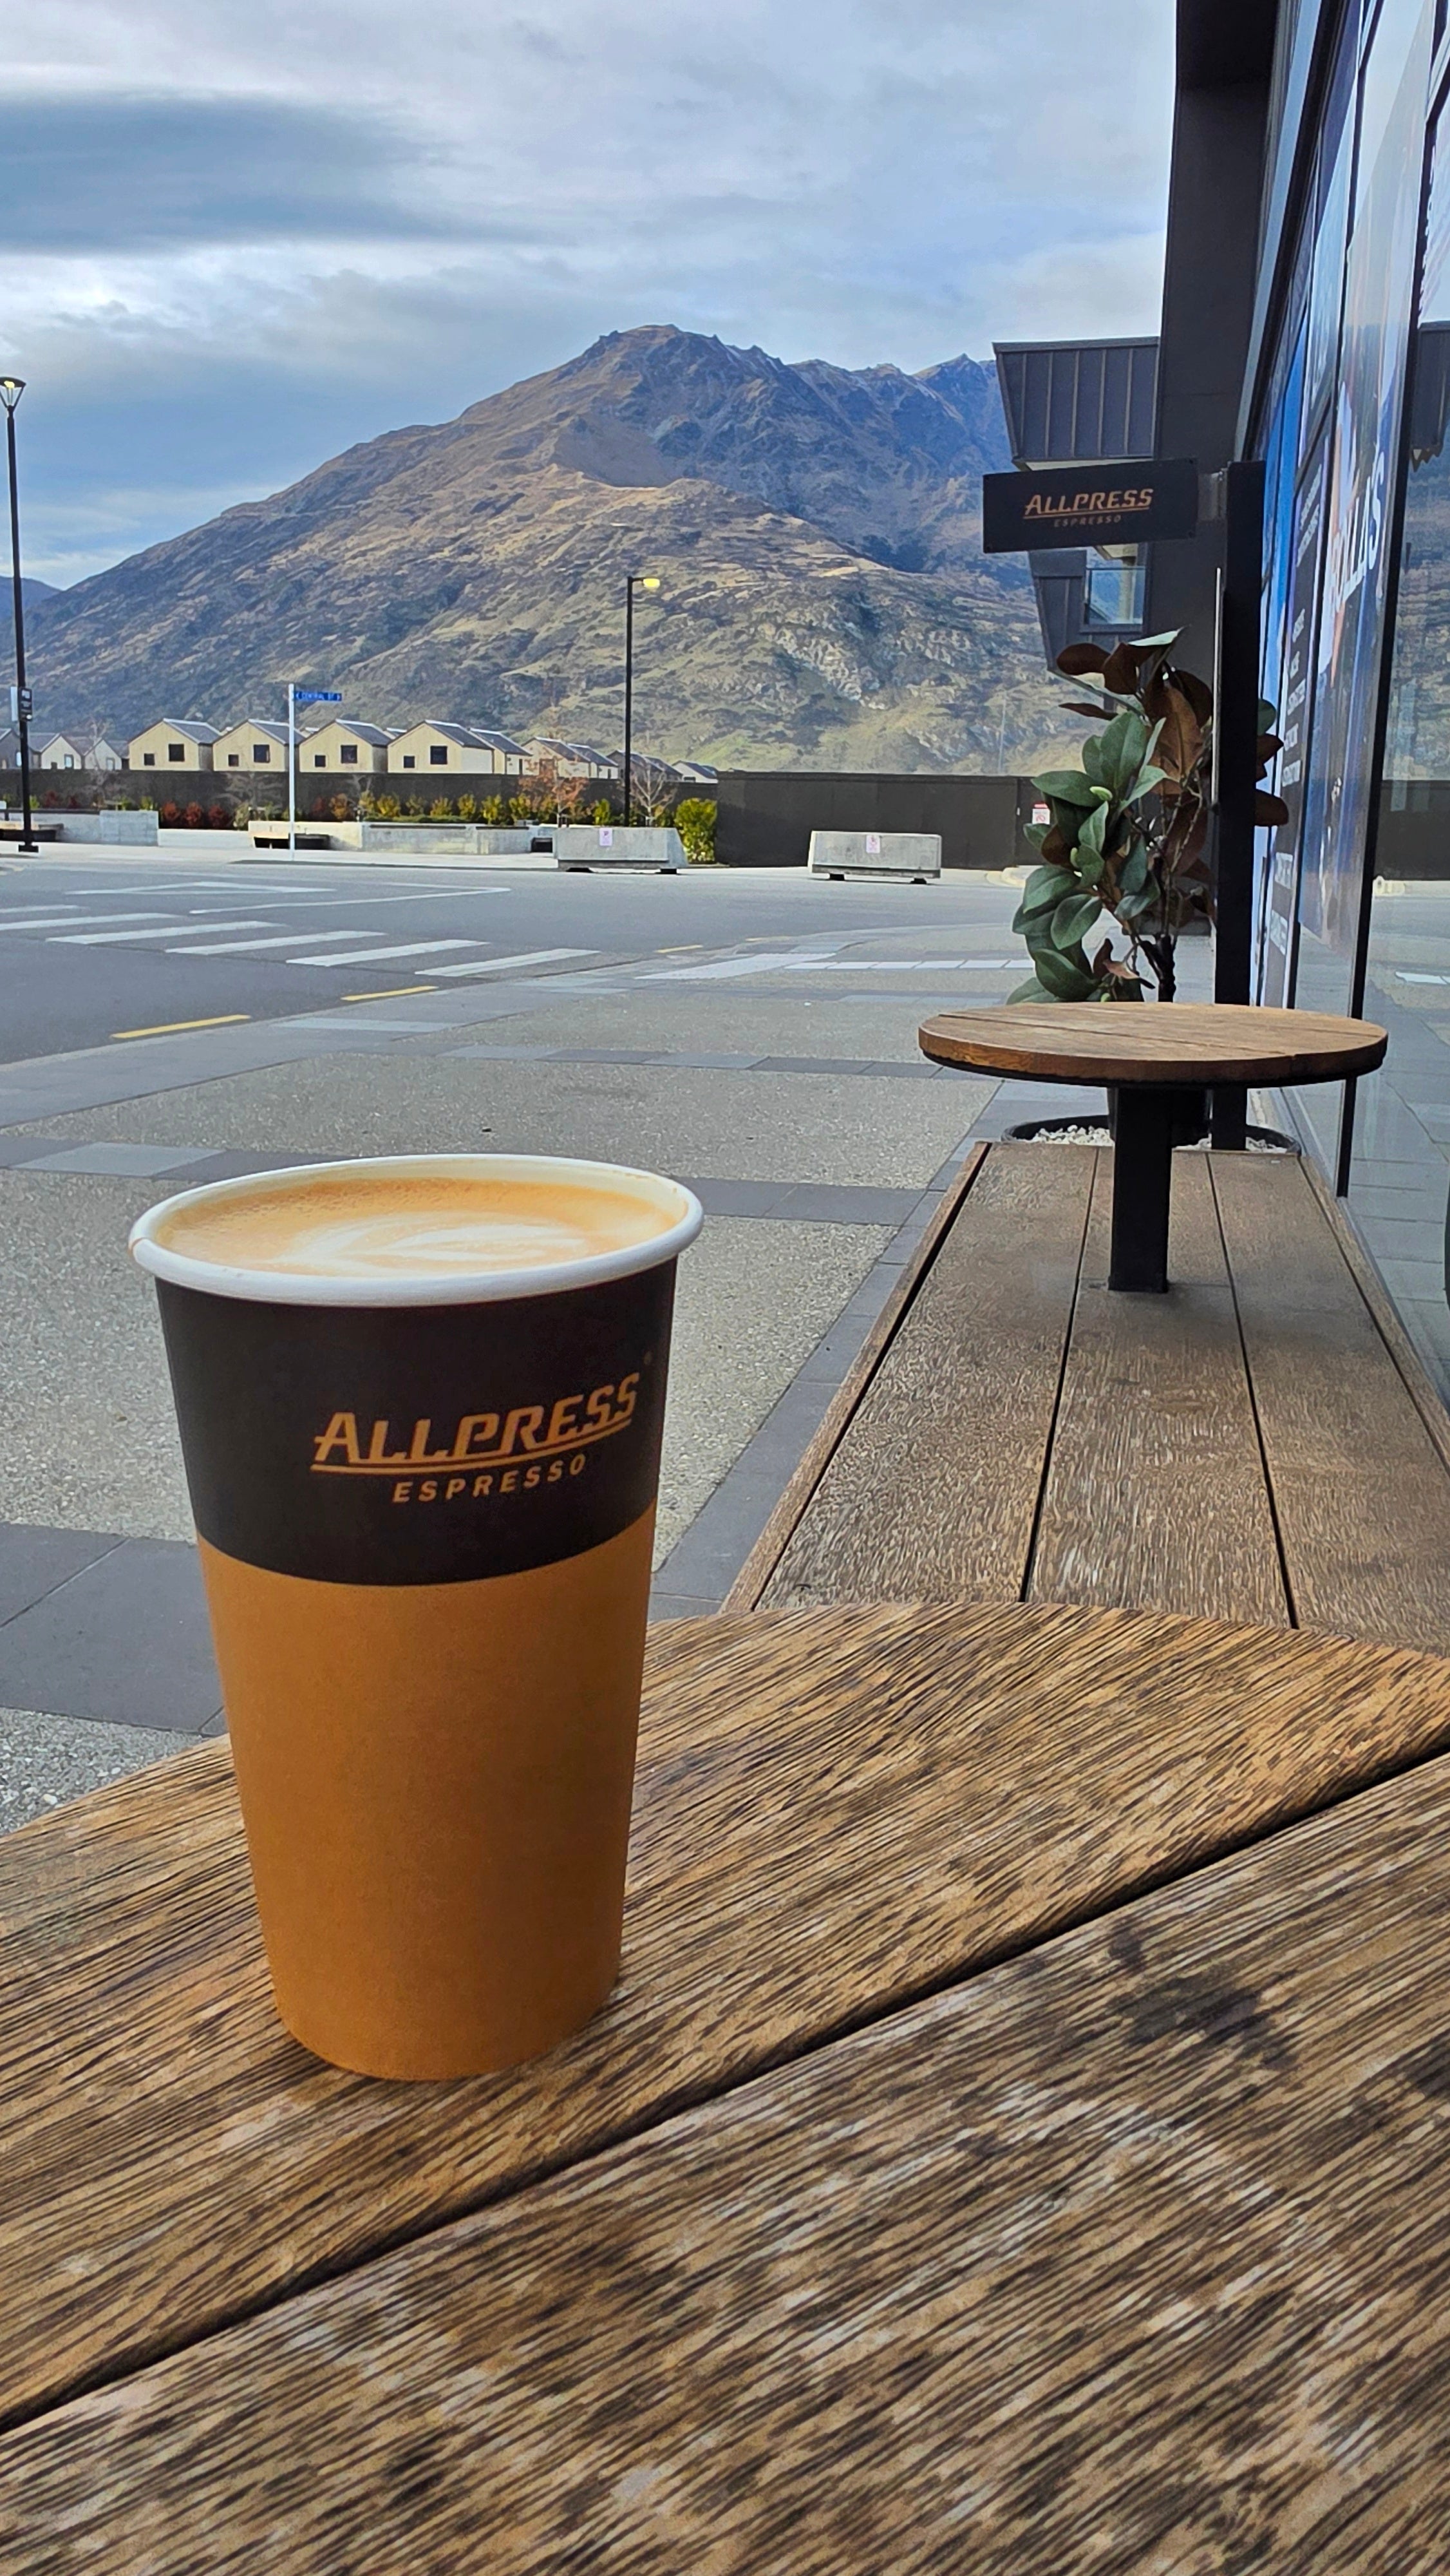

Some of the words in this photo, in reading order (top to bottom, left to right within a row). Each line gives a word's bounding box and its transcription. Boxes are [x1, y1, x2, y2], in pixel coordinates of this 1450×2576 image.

[1024, 488, 1154, 516] ALLPRESS
[1054, 515, 1122, 527] ESPRESSO
[314, 1372, 640, 1463] ALLPRESS
[392, 1454, 586, 1504] ESPRESSO
